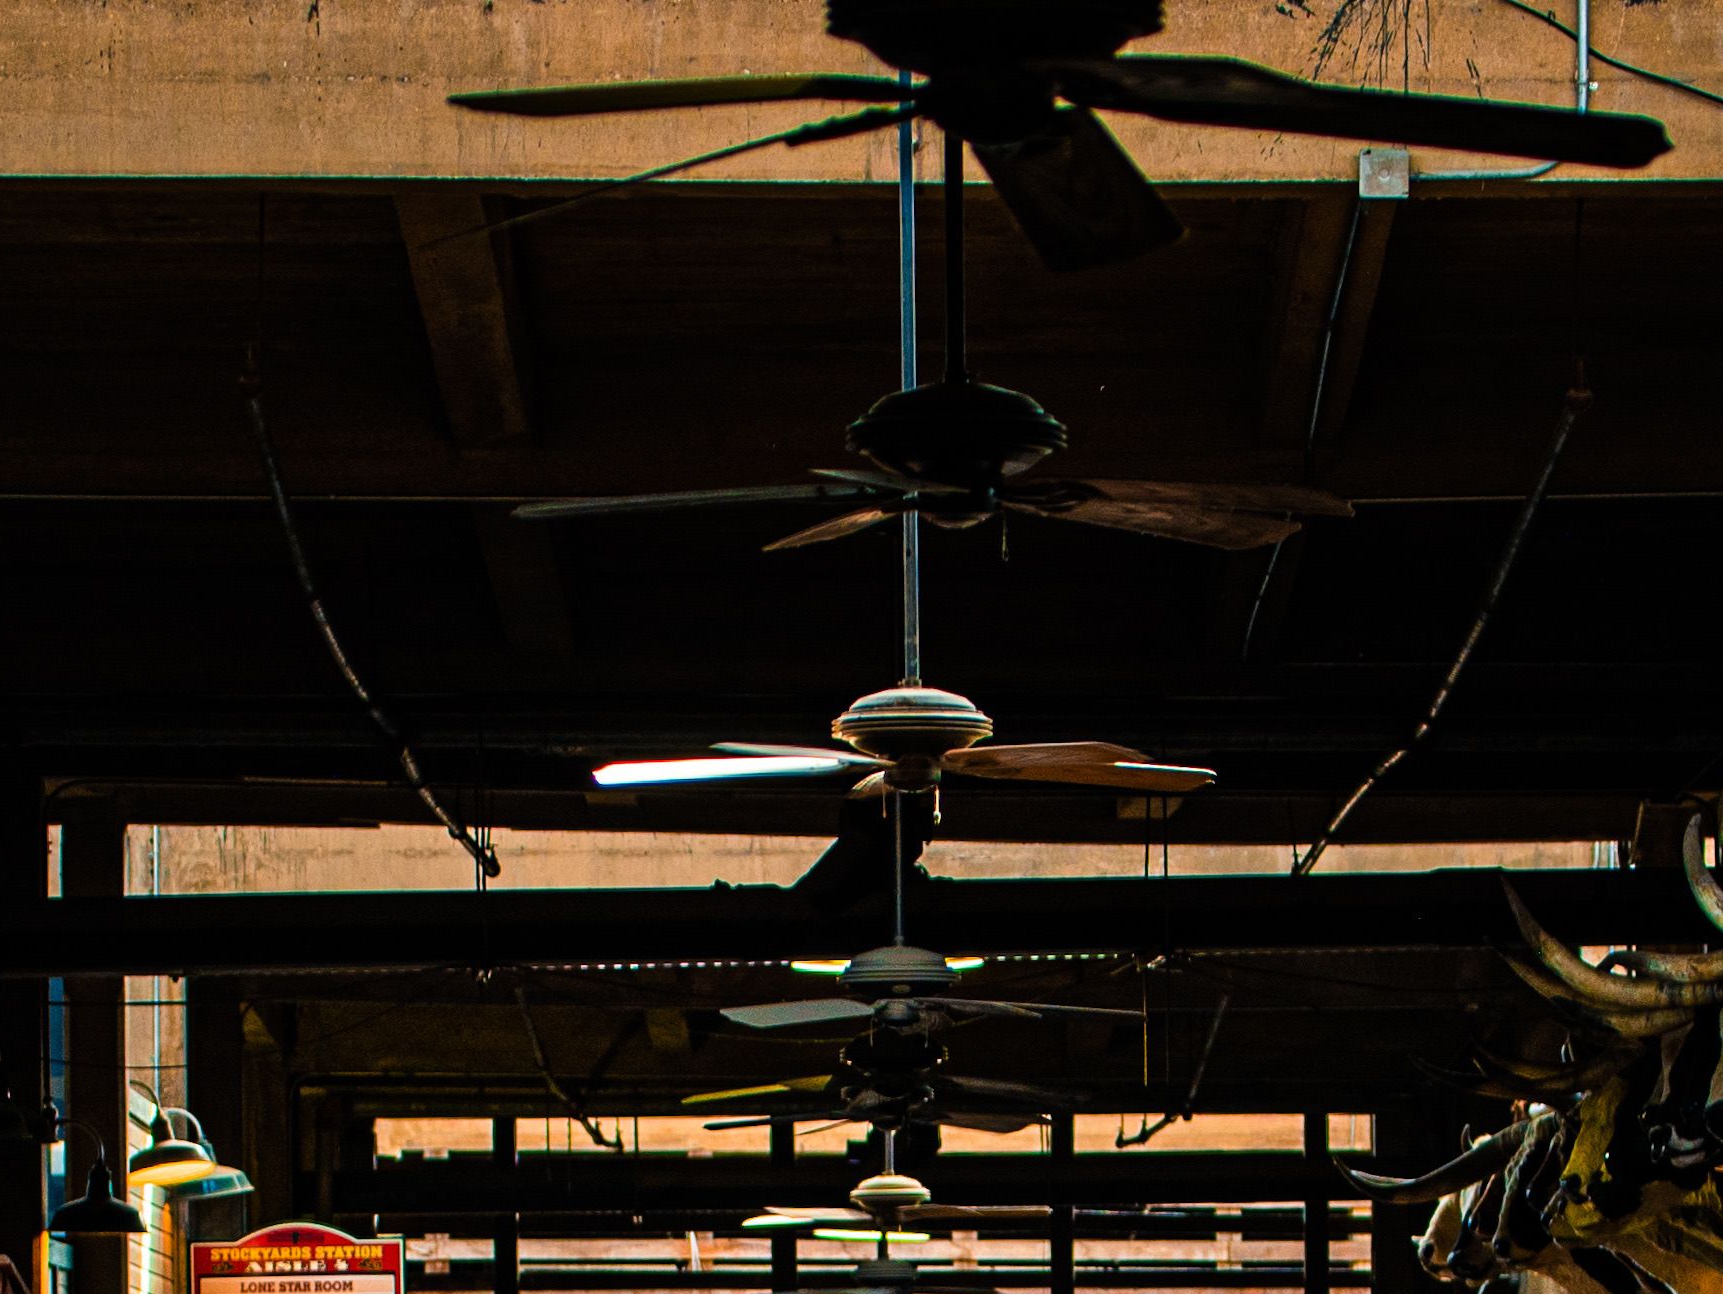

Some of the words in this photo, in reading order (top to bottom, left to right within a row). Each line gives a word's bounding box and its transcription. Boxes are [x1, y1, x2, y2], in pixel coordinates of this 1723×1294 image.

[210, 1246, 311, 1262] STOCKYARDS
[315, 1245, 383, 1259] STATION
[245, 1260, 326, 1272] AISLE
[240, 1281, 276, 1294] LONE
[279, 1280, 311, 1293] STAR
[314, 1280, 353, 1292] ROOM
